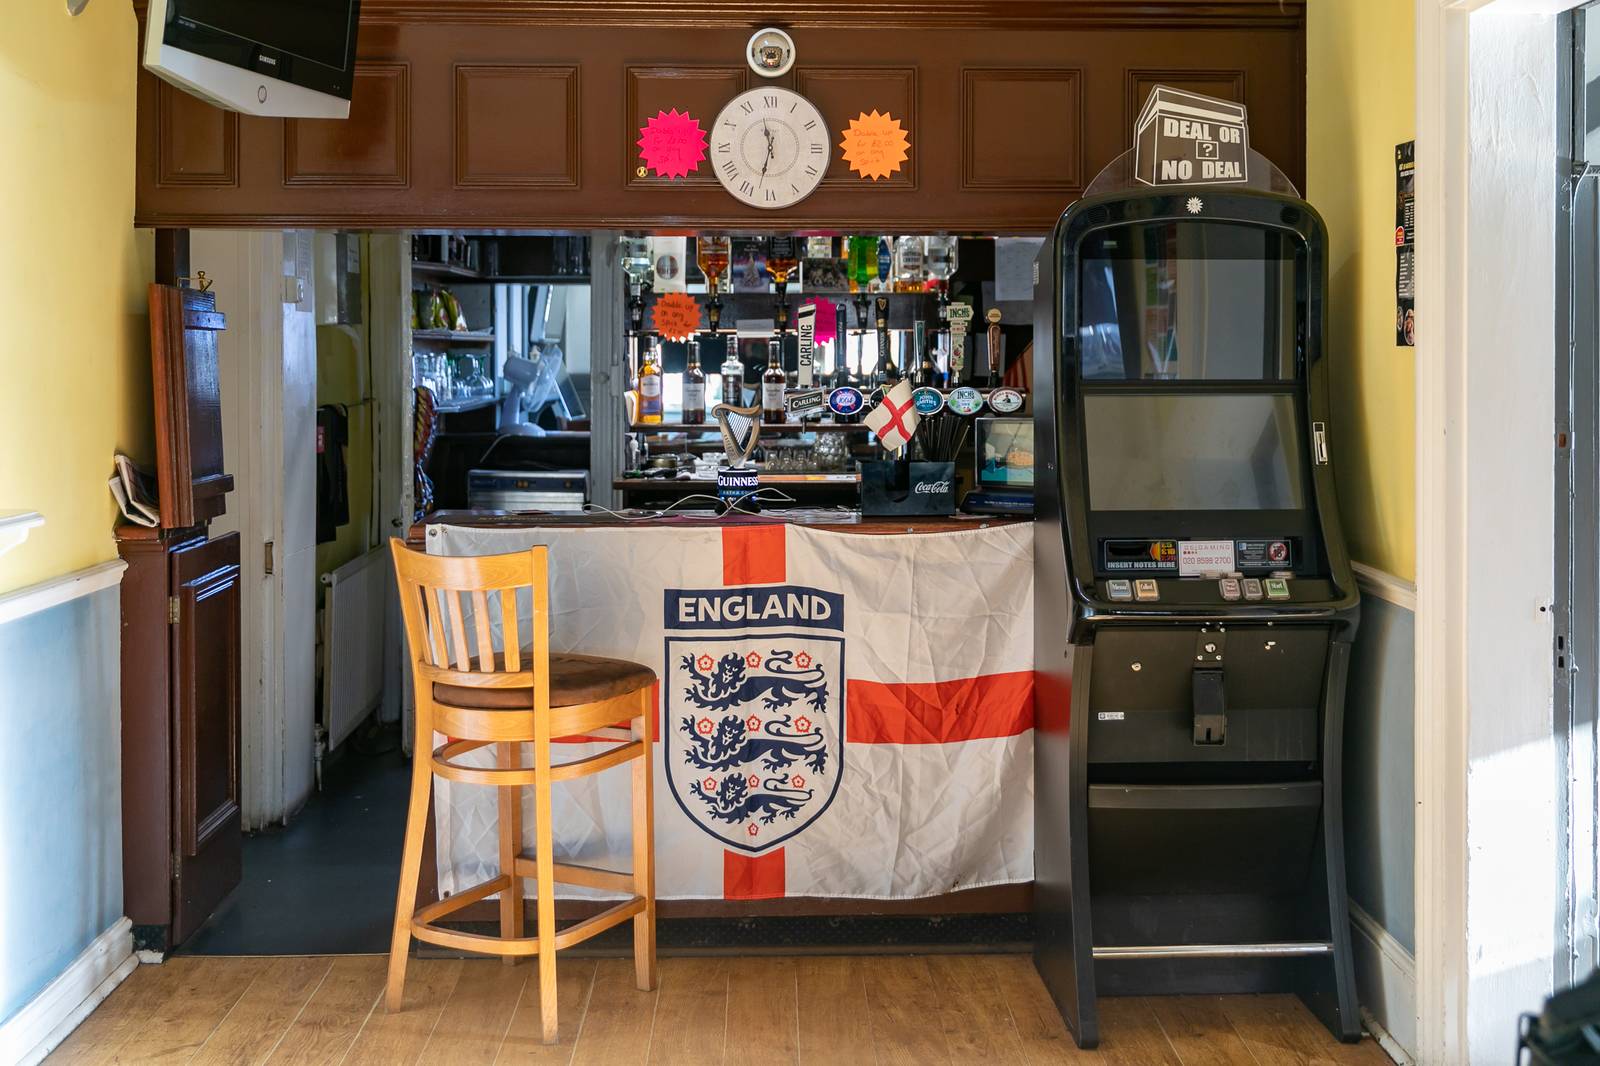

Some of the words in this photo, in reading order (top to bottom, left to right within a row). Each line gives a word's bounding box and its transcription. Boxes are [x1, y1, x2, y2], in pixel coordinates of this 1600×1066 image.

[259, 54, 276, 66] SAMSUNG
[763, 96, 777, 108] XII
[1163, 117, 1213, 141] DEAL
[1219, 126, 1241, 144] OR
[810, 143, 823, 154] III
[1202, 143, 1213, 156] ?
[1161, 160, 1193, 181] NO
[1202, 161, 1242, 179] DEAL
[800, 324, 813, 367] CARLING
[792, 395, 821, 409] CARLING
[717, 475, 759, 487] GUINNESS
[1183, 557, 1196, 565] 020
[1214, 557, 1232, 565] 2700
[678, 593, 832, 622] ENGLAND
